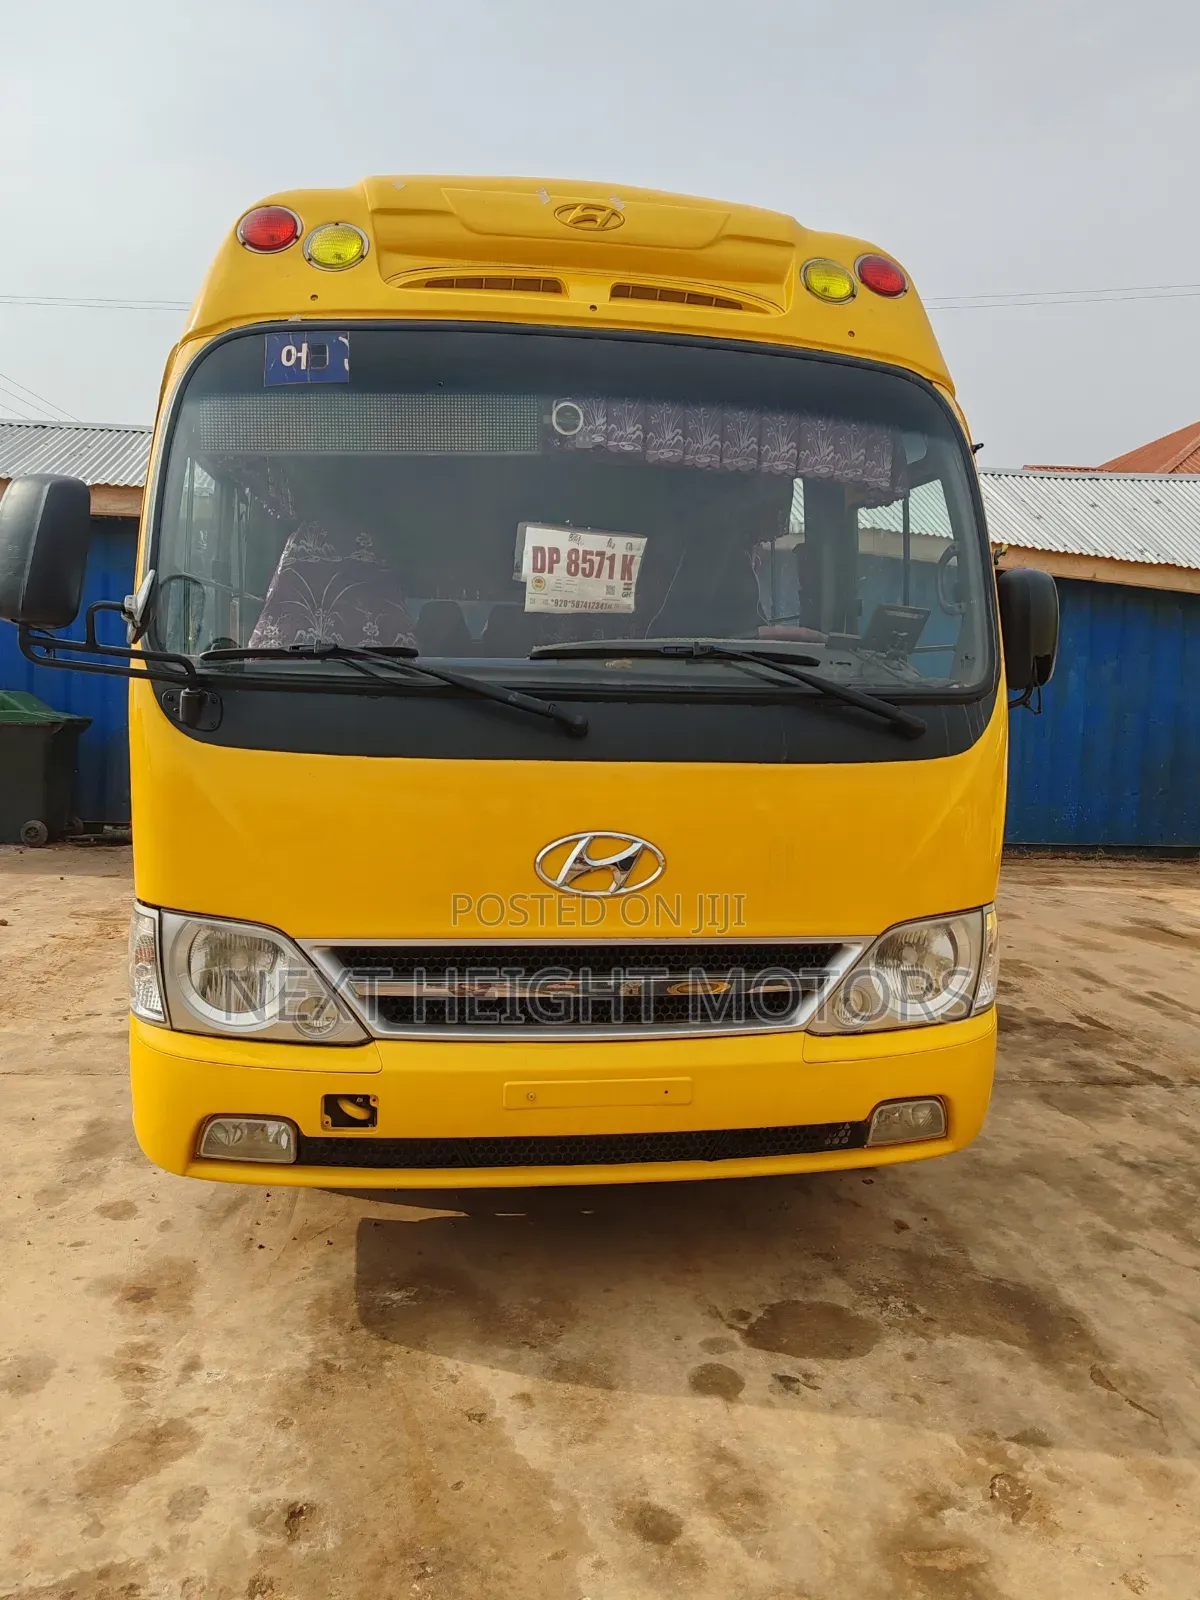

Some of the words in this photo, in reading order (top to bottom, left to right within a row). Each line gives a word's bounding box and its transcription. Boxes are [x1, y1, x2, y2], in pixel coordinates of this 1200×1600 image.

[532, 546, 561, 574] DP
[566, 548, 616, 580] 8571
[620, 554, 636, 581] K
